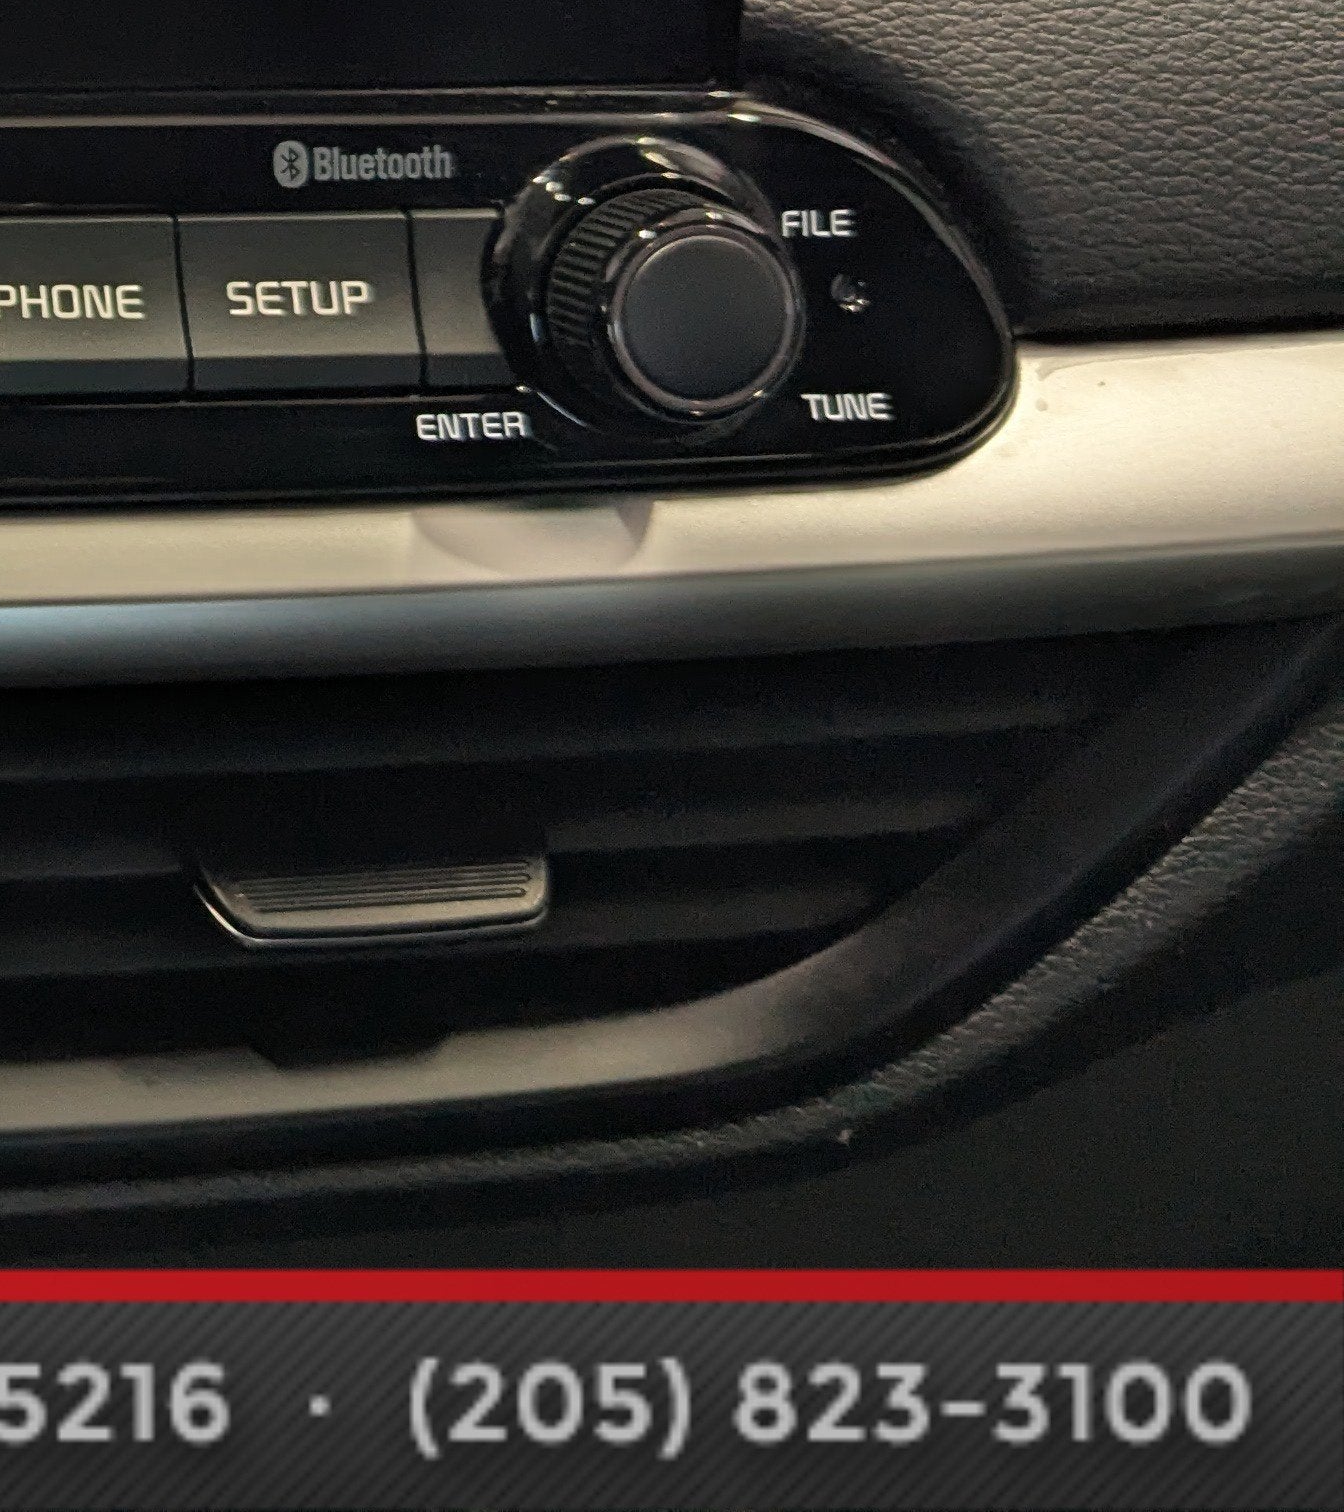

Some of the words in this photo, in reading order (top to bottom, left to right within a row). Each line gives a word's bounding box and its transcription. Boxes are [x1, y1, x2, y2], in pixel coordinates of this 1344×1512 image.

[312, 144, 453, 182] Bluetooth
[782, 208, 855, 239] FILE
[226, 280, 370, 316] SETUP
[802, 393, 894, 421] TUNE
[416, 412, 528, 442] ENTER
